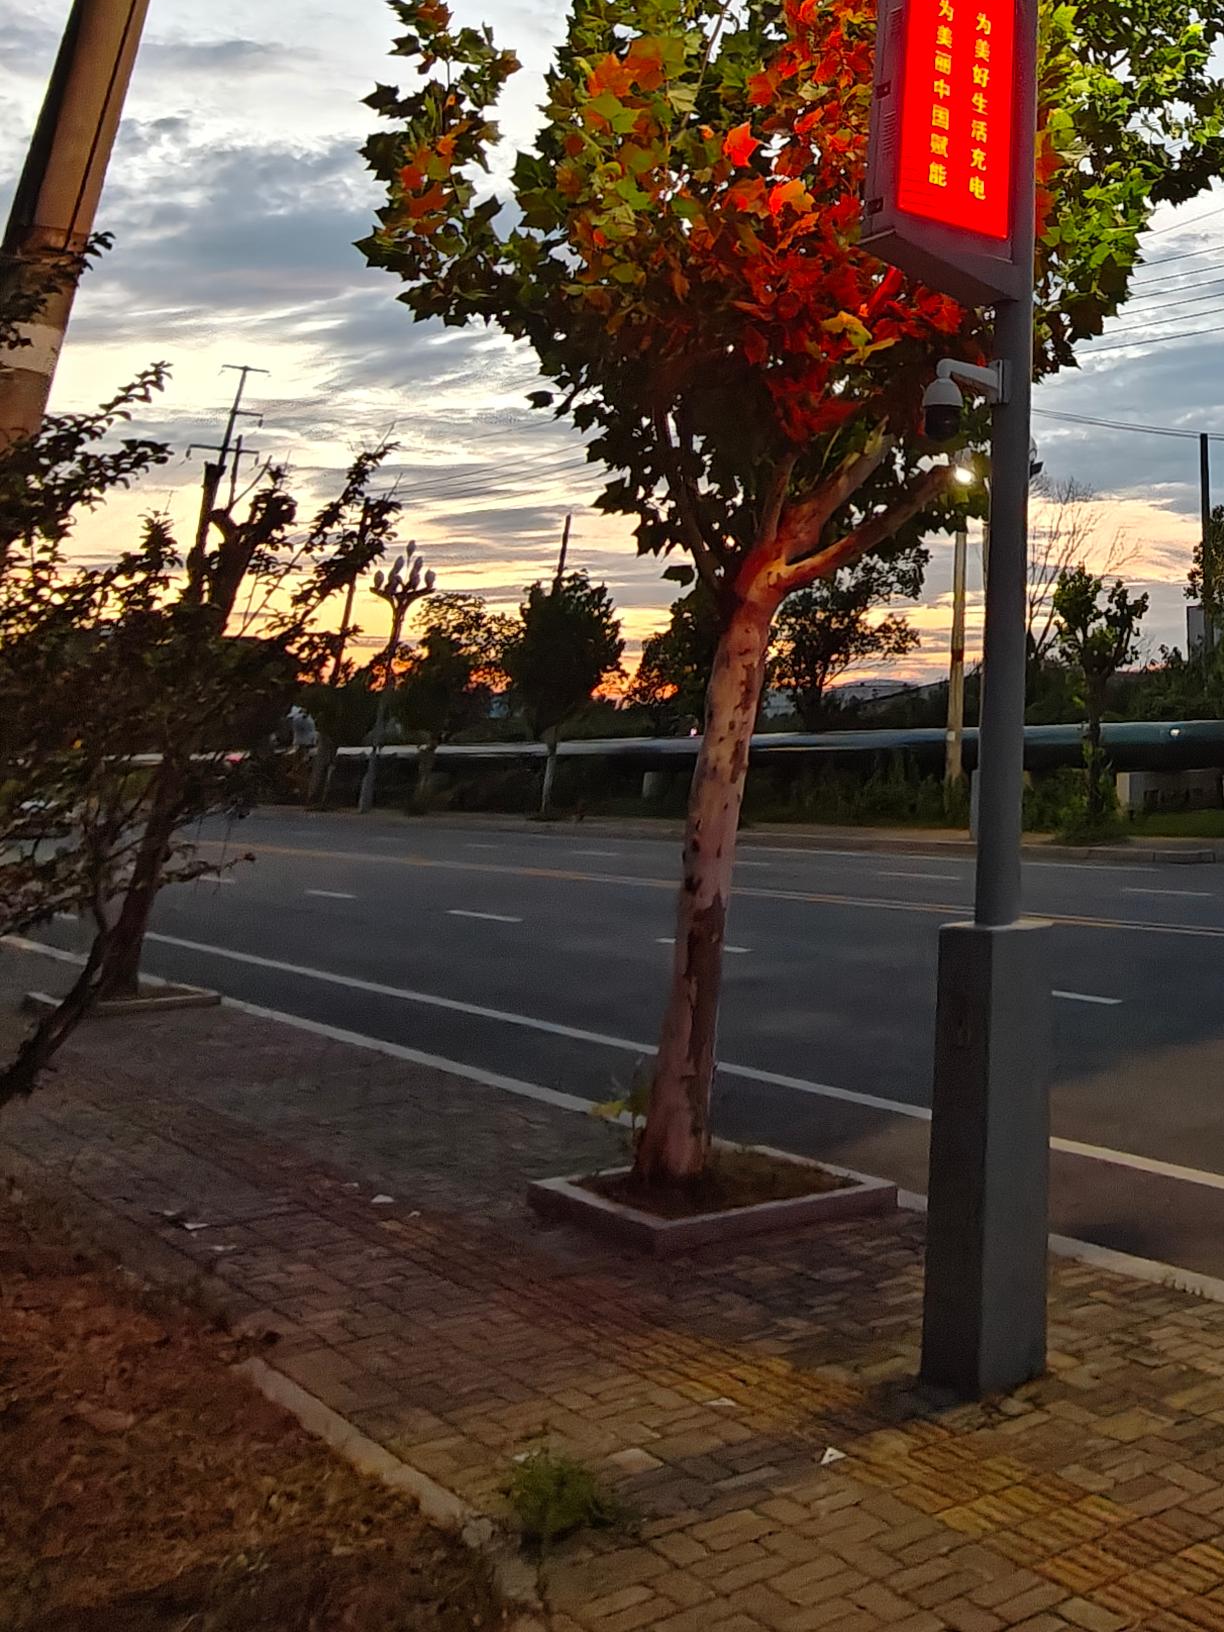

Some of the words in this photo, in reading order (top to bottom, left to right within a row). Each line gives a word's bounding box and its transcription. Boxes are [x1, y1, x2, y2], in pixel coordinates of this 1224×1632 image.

[969, 13, 991, 200] 为美好生活充电
